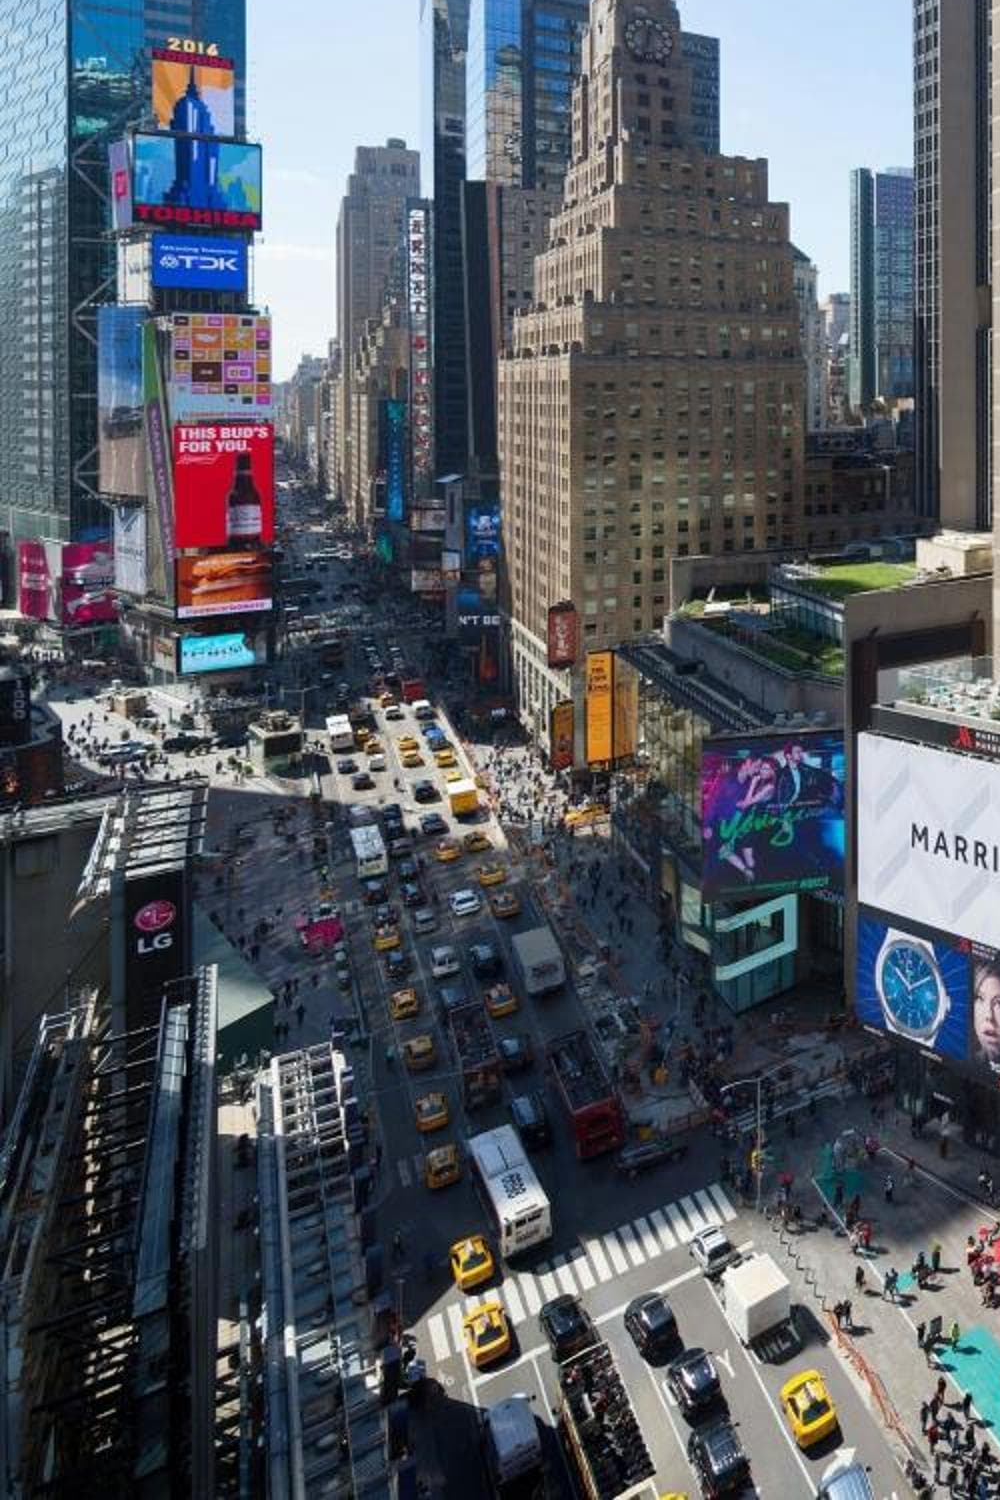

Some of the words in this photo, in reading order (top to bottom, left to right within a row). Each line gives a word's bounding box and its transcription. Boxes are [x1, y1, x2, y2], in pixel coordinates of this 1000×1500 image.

[135, 203, 258, 228] TOSHIBA
[178, 254, 238, 271] TDK
[179, 427, 216, 440] THIS
[219, 426, 269, 440] BUD'S
[179, 441, 212, 453] FOR
[215, 439, 252, 452] YOU.
[137, 932, 173, 954] LG
